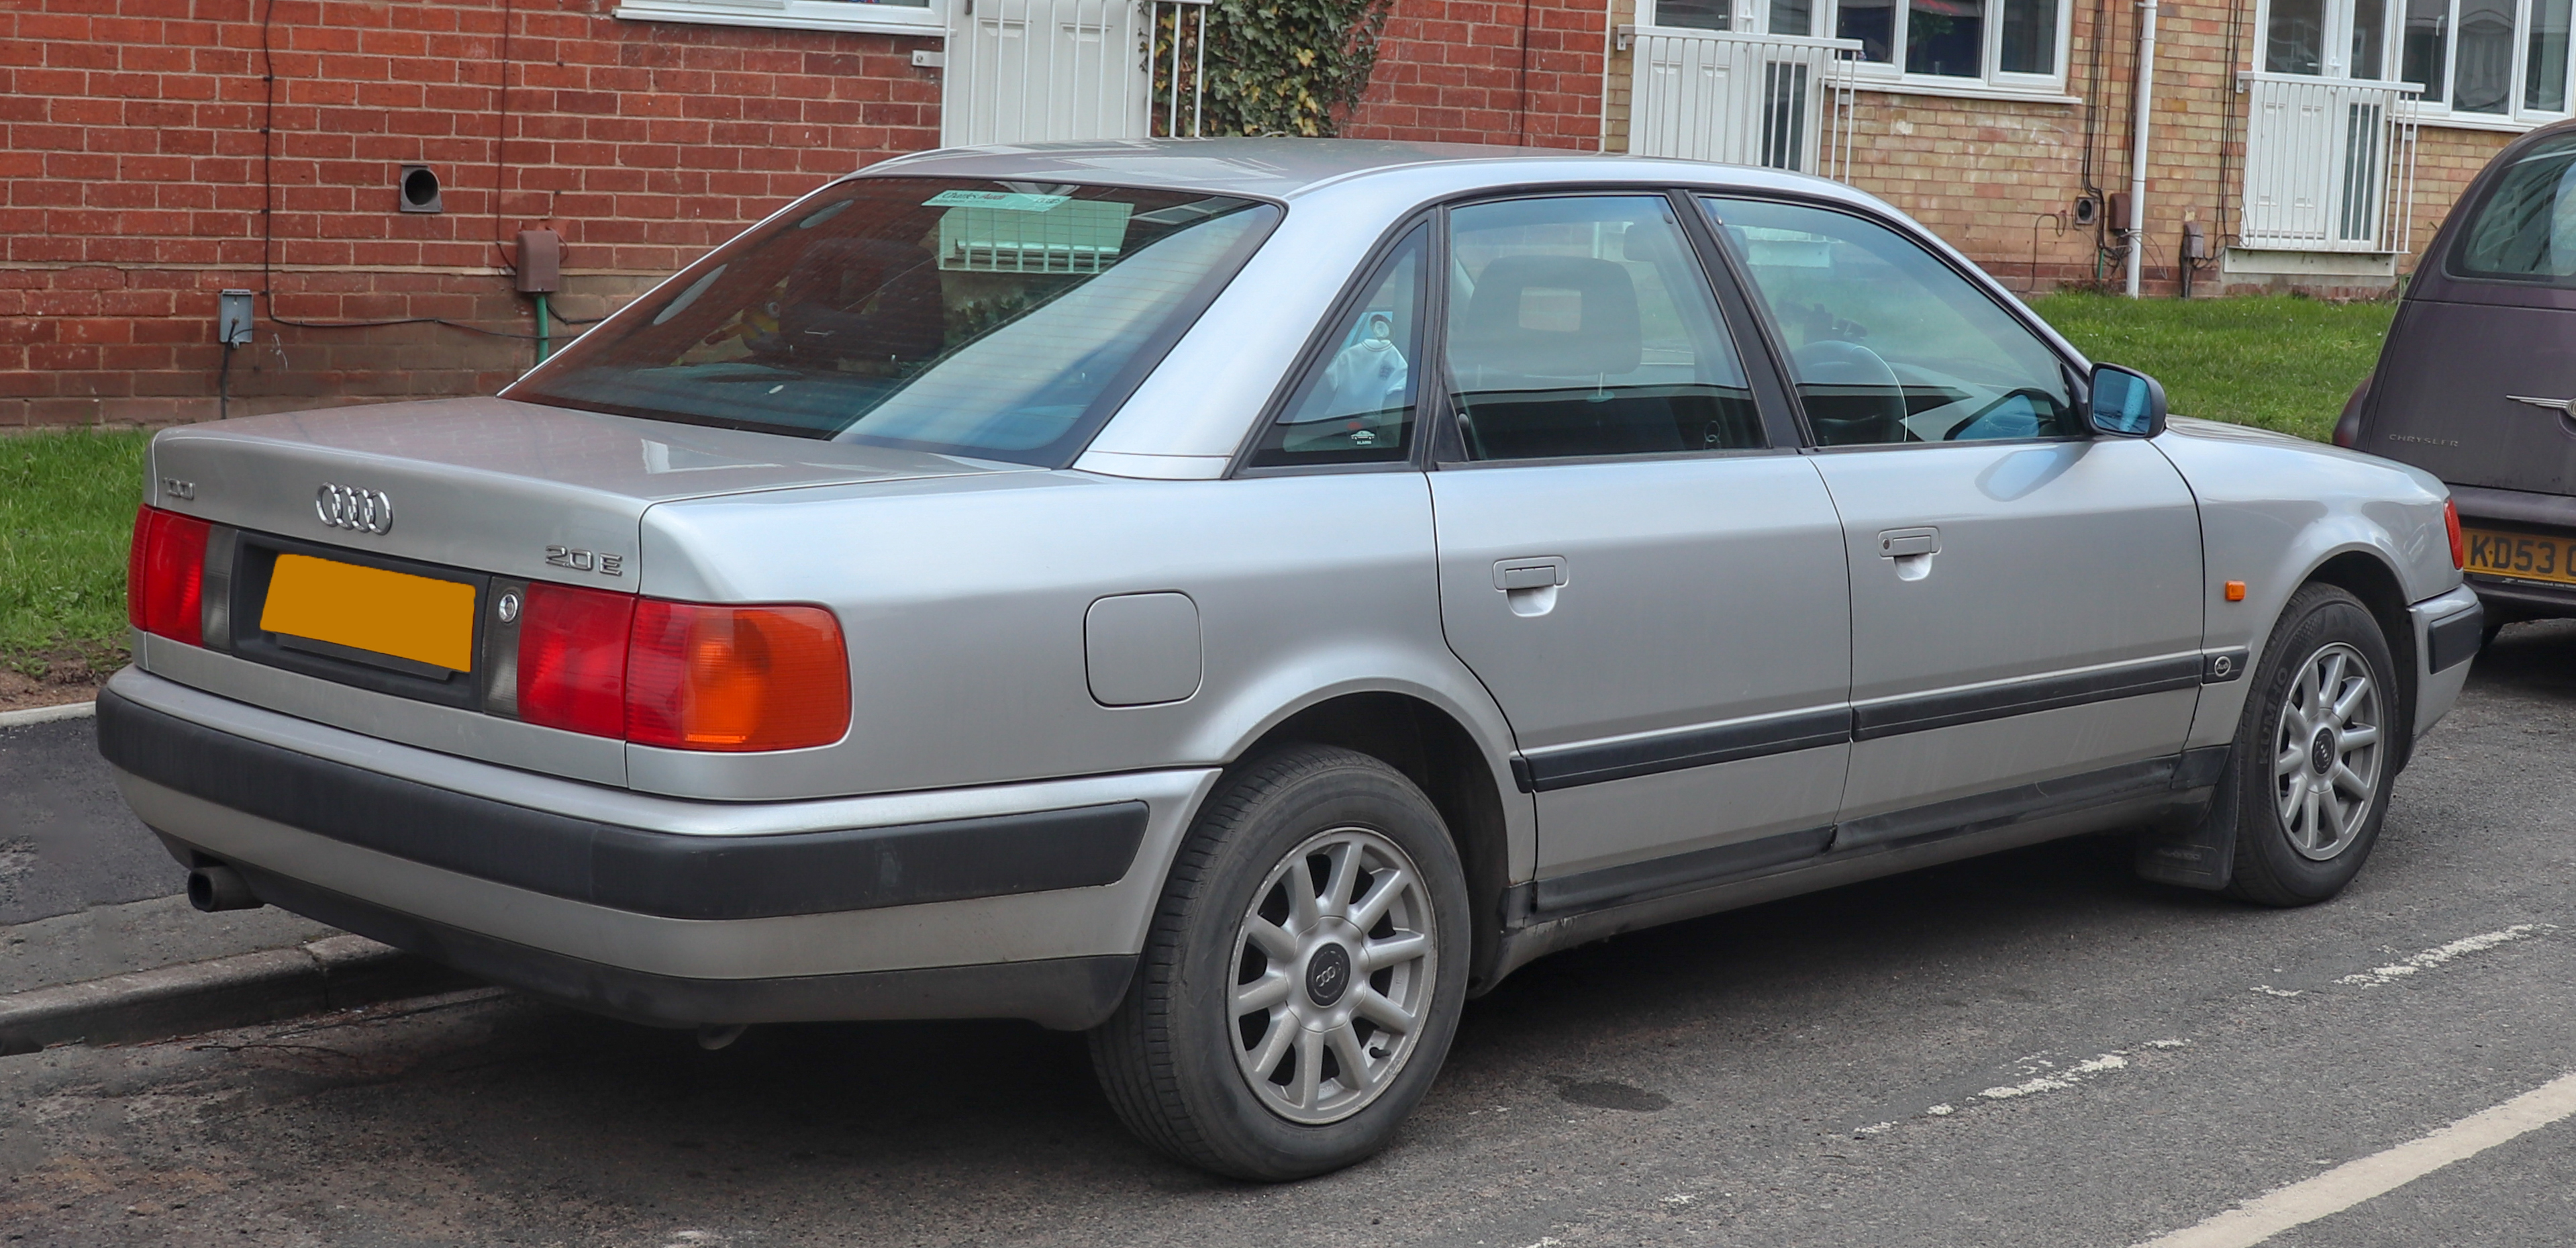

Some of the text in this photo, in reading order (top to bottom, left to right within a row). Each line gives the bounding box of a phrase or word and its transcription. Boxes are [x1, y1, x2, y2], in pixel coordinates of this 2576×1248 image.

[2389, 434, 2459, 447] CHRYSLER
[599, 553, 622, 577] E
[2471, 535, 2556, 574] KD53
[2259, 667, 2288, 764] KUMHO
